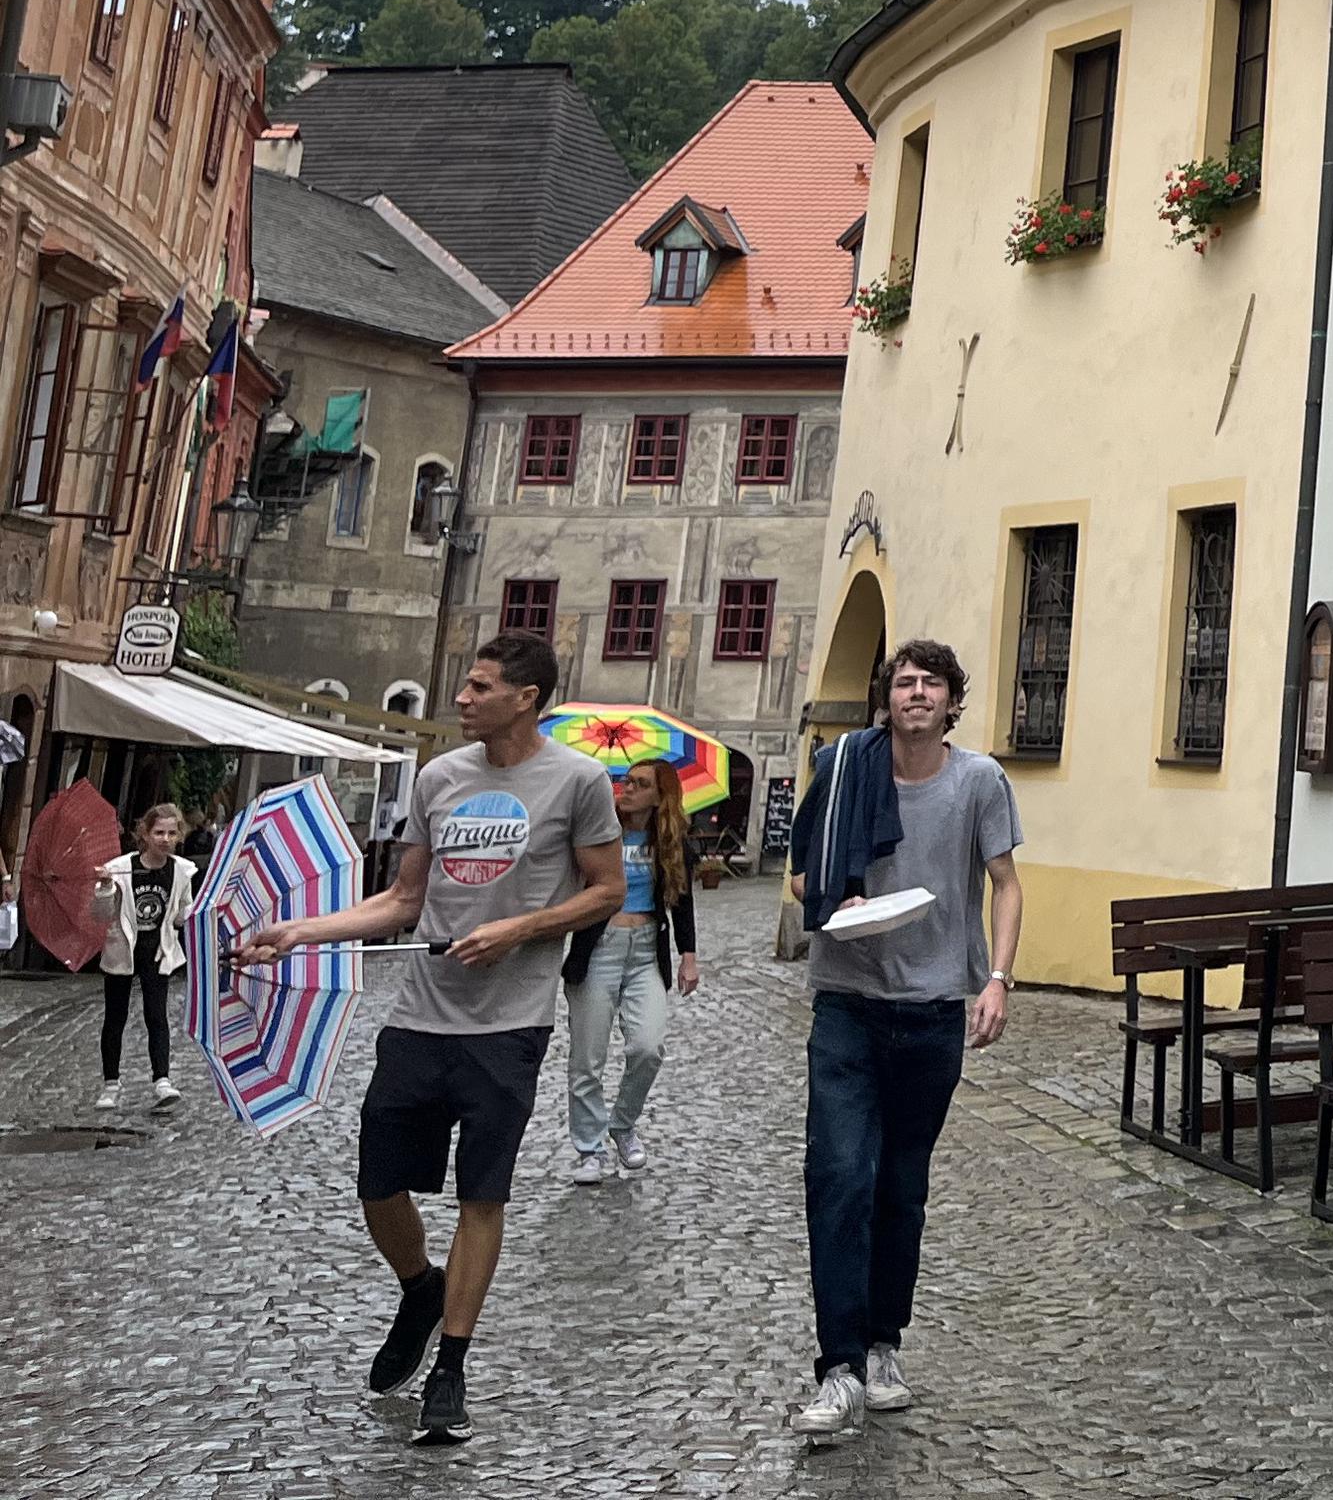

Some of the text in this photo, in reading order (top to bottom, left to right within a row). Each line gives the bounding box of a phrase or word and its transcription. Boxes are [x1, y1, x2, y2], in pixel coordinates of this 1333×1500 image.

[127, 611, 176, 624] HOSPODA
[121, 650, 169, 667] HOTEL
[440, 822, 527, 849] Prague
